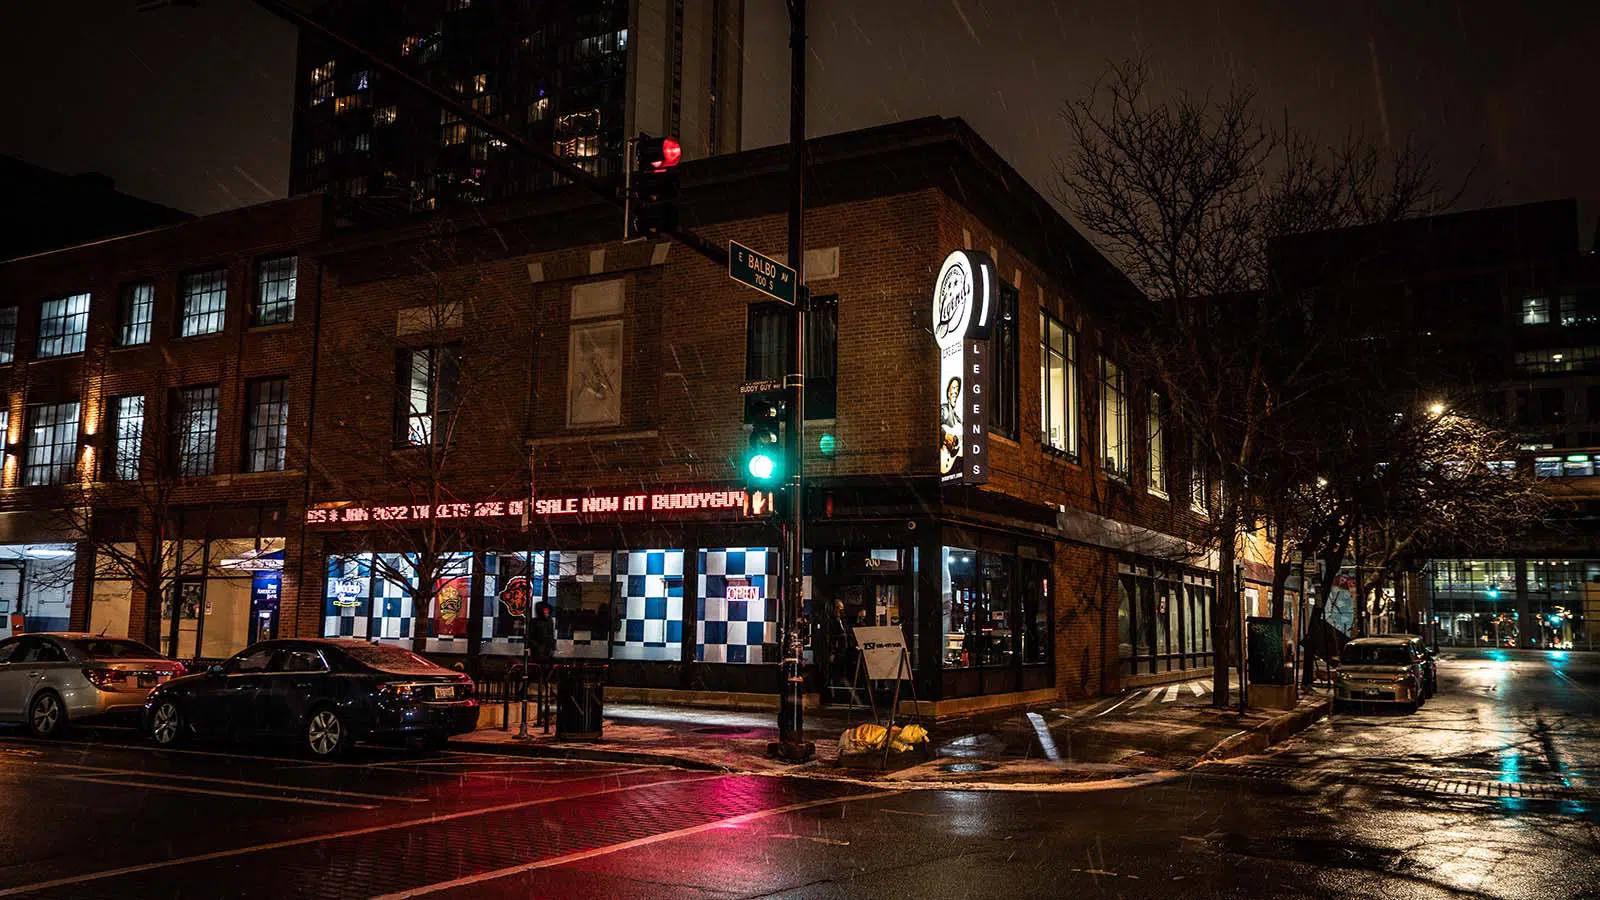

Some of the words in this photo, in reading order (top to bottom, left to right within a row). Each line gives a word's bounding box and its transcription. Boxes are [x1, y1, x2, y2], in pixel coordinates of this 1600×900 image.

[738, 251, 744, 263] E
[748, 254, 776, 279] BALBO
[781, 272, 789, 283] AV
[755, 273, 767, 287] 700
[769, 280, 774, 291] S
[740, 385, 759, 393] BUDDY
[760, 383, 772, 391] GUY
[972, 344, 981, 475] LEGENDS
[341, 507, 369, 521] JAN
[536, 498, 579, 514] SALE
[582, 496, 620, 513] NOW
[623, 495, 648, 511] AT
[651, 491, 745, 510] BUDDYGUY
[865, 558, 880, 567] 700
[727, 586, 760, 601] OPEN
